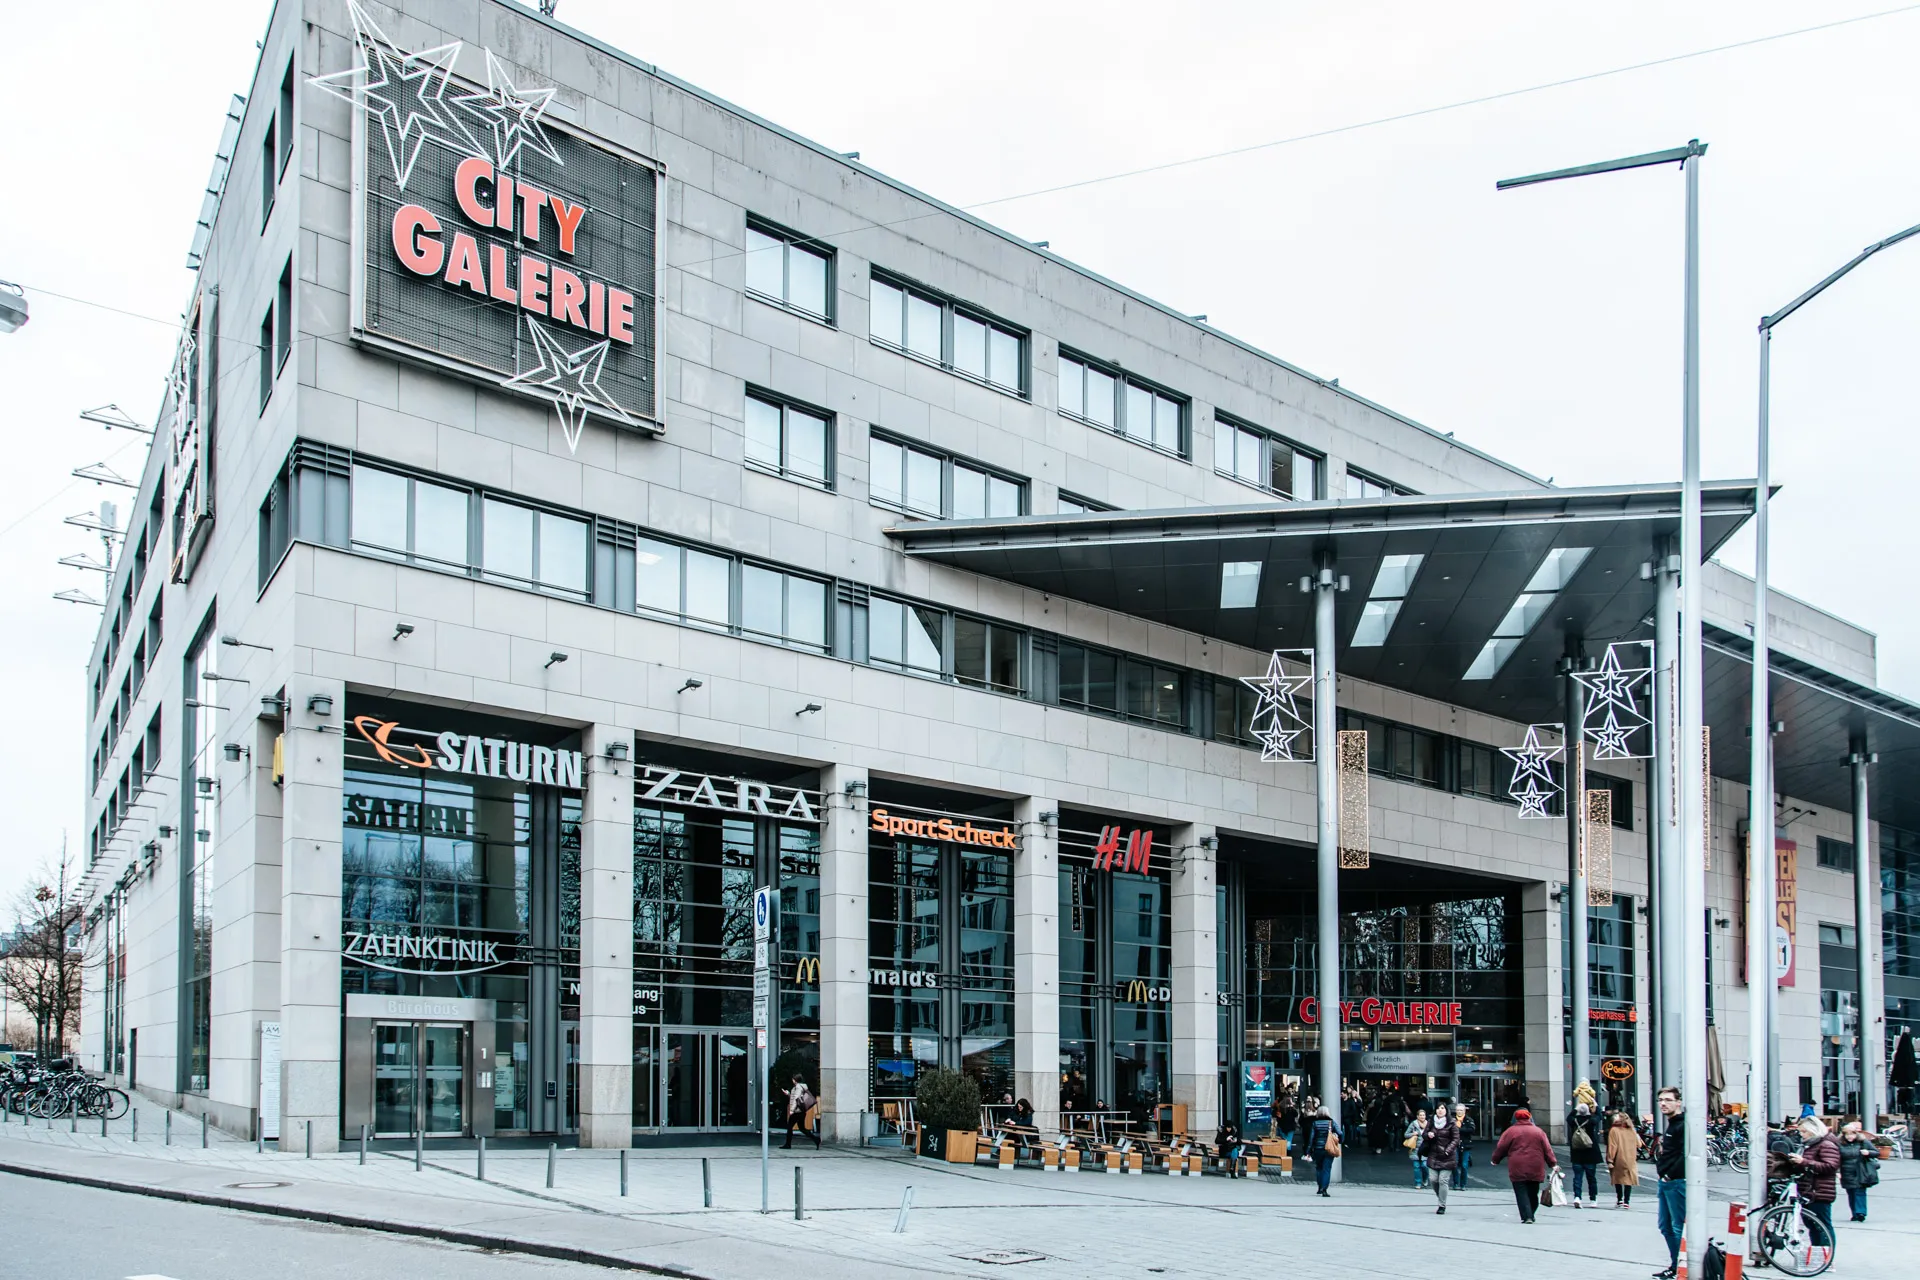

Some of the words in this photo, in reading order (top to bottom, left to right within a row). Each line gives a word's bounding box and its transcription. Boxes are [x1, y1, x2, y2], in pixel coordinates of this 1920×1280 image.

[455, 156, 586, 255] CITY
[392, 204, 635, 346] GALERIE
[436, 730, 582, 789] SATURN
[643, 767, 815, 821] ZARA
[871, 808, 1017, 849] SportScheck
[1091, 824, 1153, 876] H&M
[345, 931, 500, 963] ZAHNKLINIK
[387, 1000, 459, 1016] Bürohaus
[481, 1047, 487, 1059] 1
[1373, 1055, 1401, 1063] Herzlich
